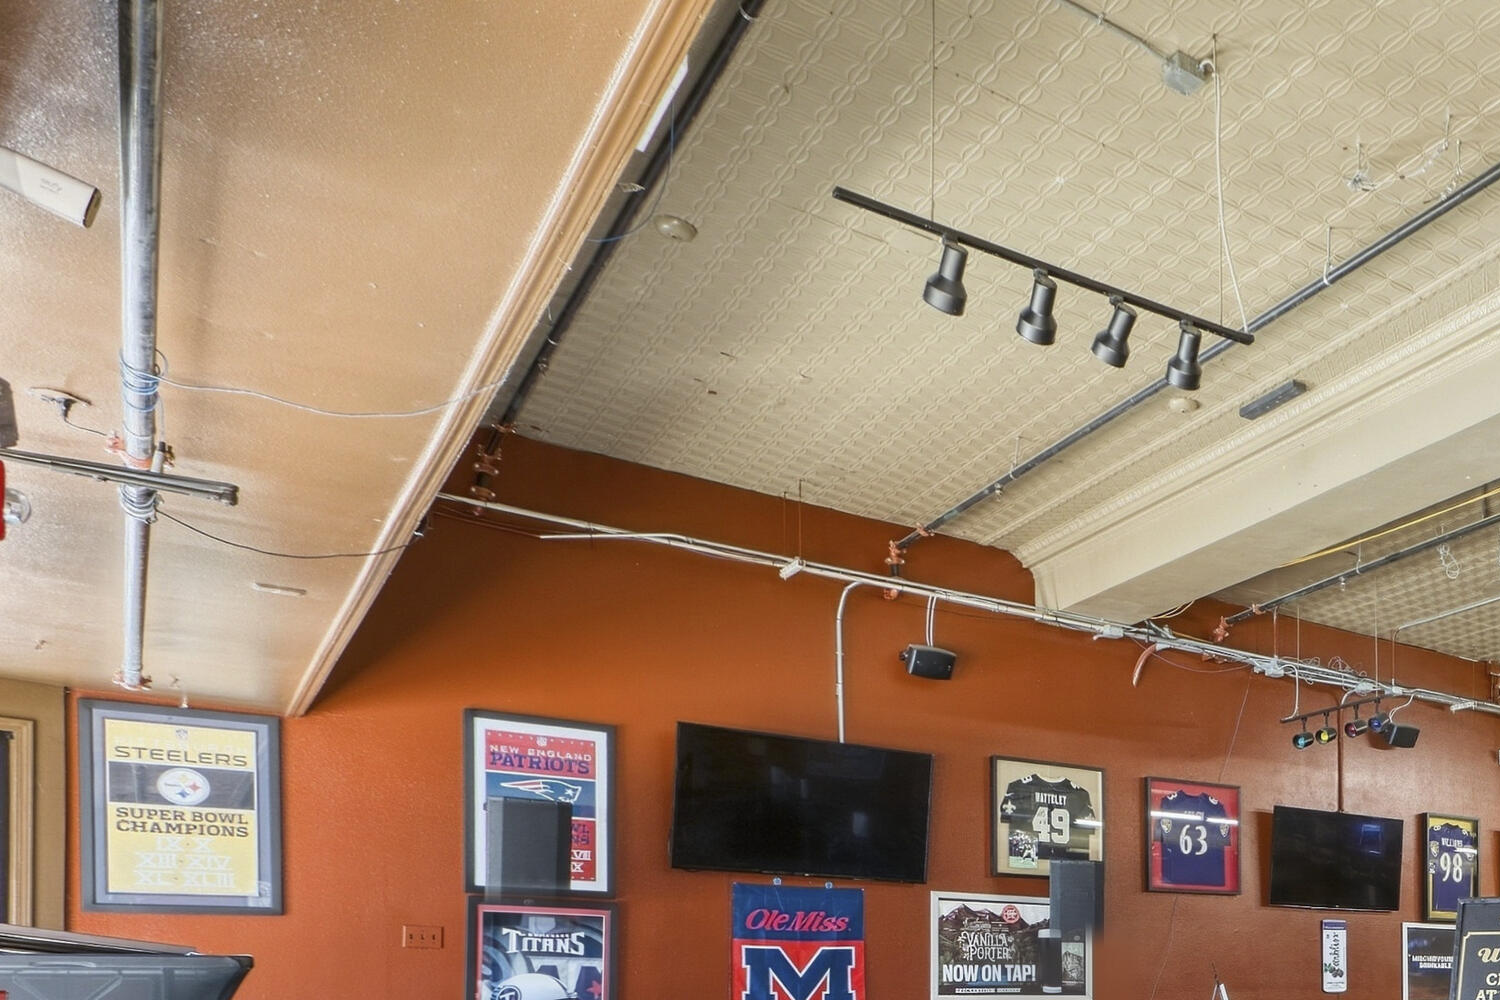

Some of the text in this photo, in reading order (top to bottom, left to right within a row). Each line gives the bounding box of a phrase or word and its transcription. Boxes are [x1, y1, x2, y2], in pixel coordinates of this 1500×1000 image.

[114, 745, 248, 768] STEELERS
[490, 744, 592, 762] NEW ENGLAND
[490, 752, 590, 775] PATRIOTS
[116, 806, 249, 825] SUPER BOWL
[1032, 806, 1070, 845] 49
[116, 819, 249, 838] CHAMPIONS
[1180, 823, 1208, 856] 63
[1440, 852, 1463, 883] 98
[745, 908, 849, 932] Ole Miss
[502, 927, 585, 956] TITANS
[961, 930, 1009, 947] VANILLA
[967, 945, 1010, 962] PORTER
[942, 964, 1037, 982] NOW ON TAP!
